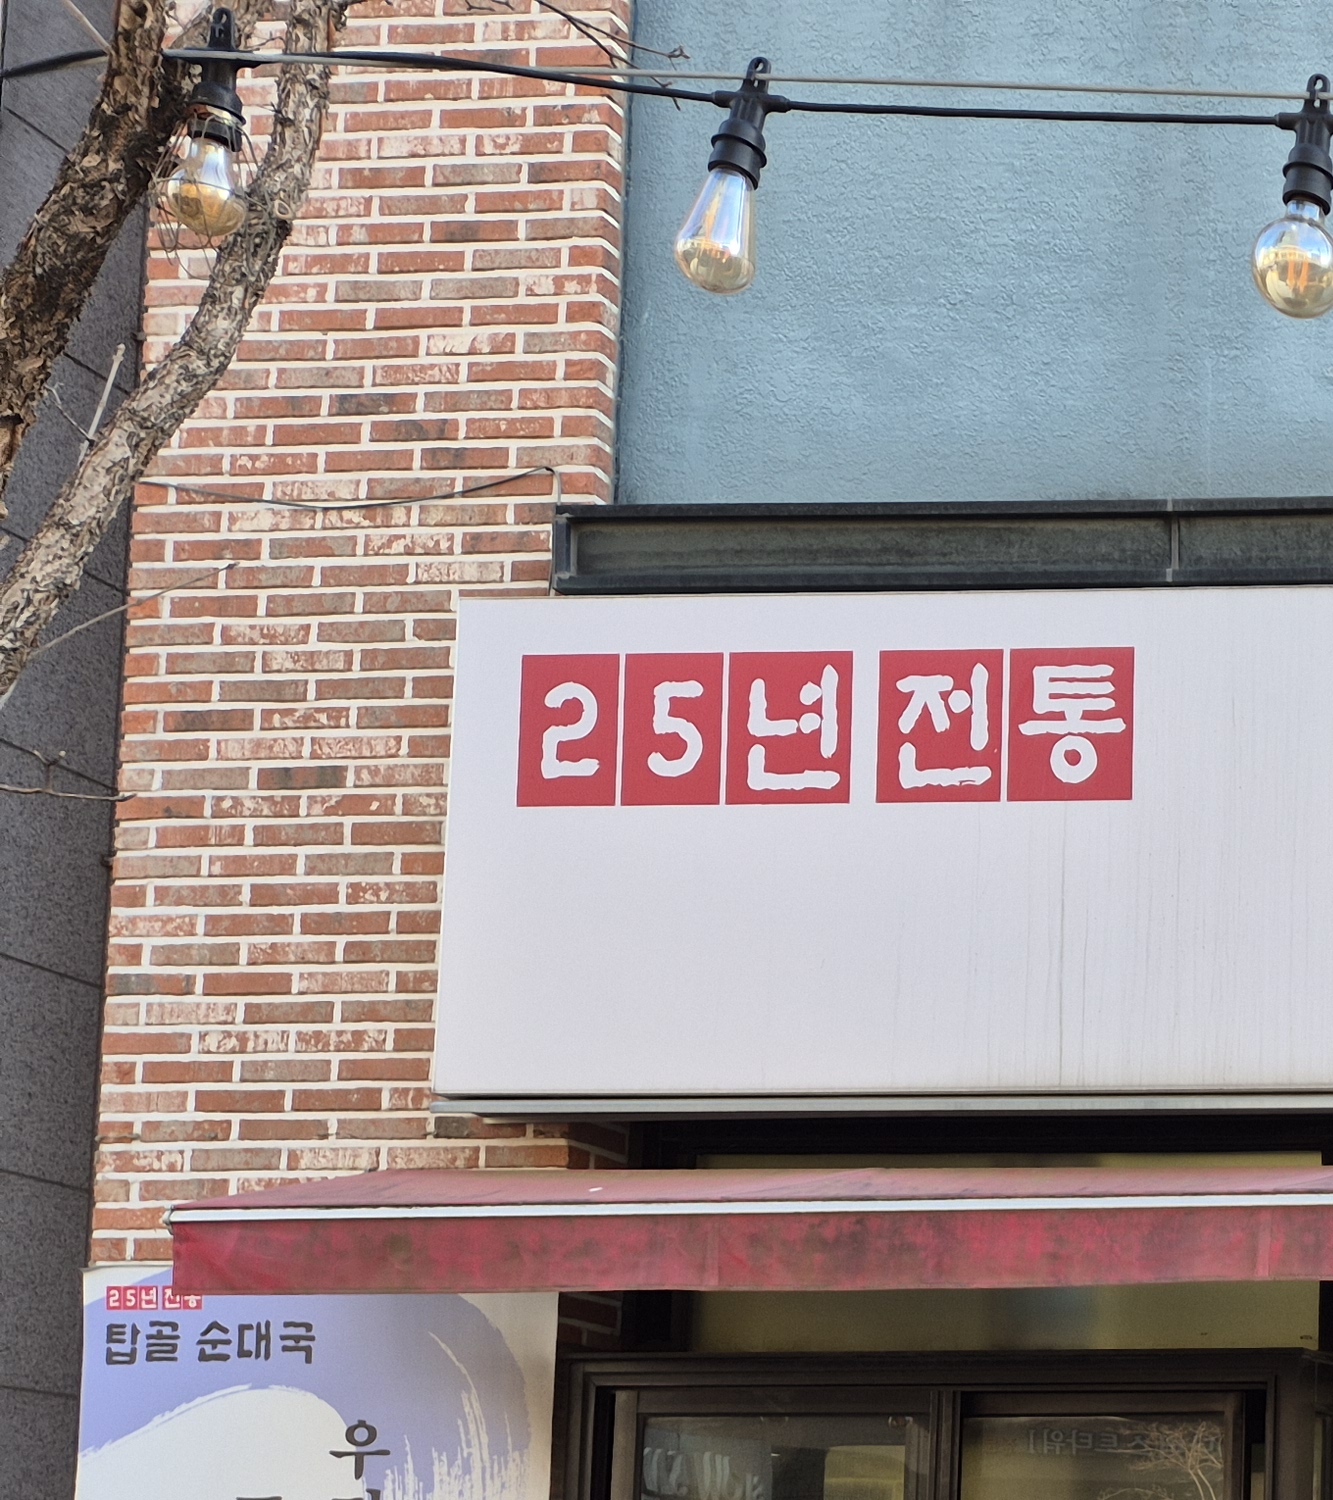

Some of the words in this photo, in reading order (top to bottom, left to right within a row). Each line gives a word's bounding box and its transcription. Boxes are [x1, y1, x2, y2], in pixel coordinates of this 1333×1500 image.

[540, 671, 841, 792] 25년
[896, 663, 1129, 789] 전통
[108, 1287, 158, 1309] 25년
[105, 1319, 181, 1366] 탑골
[195, 1319, 316, 1365] 순대국
